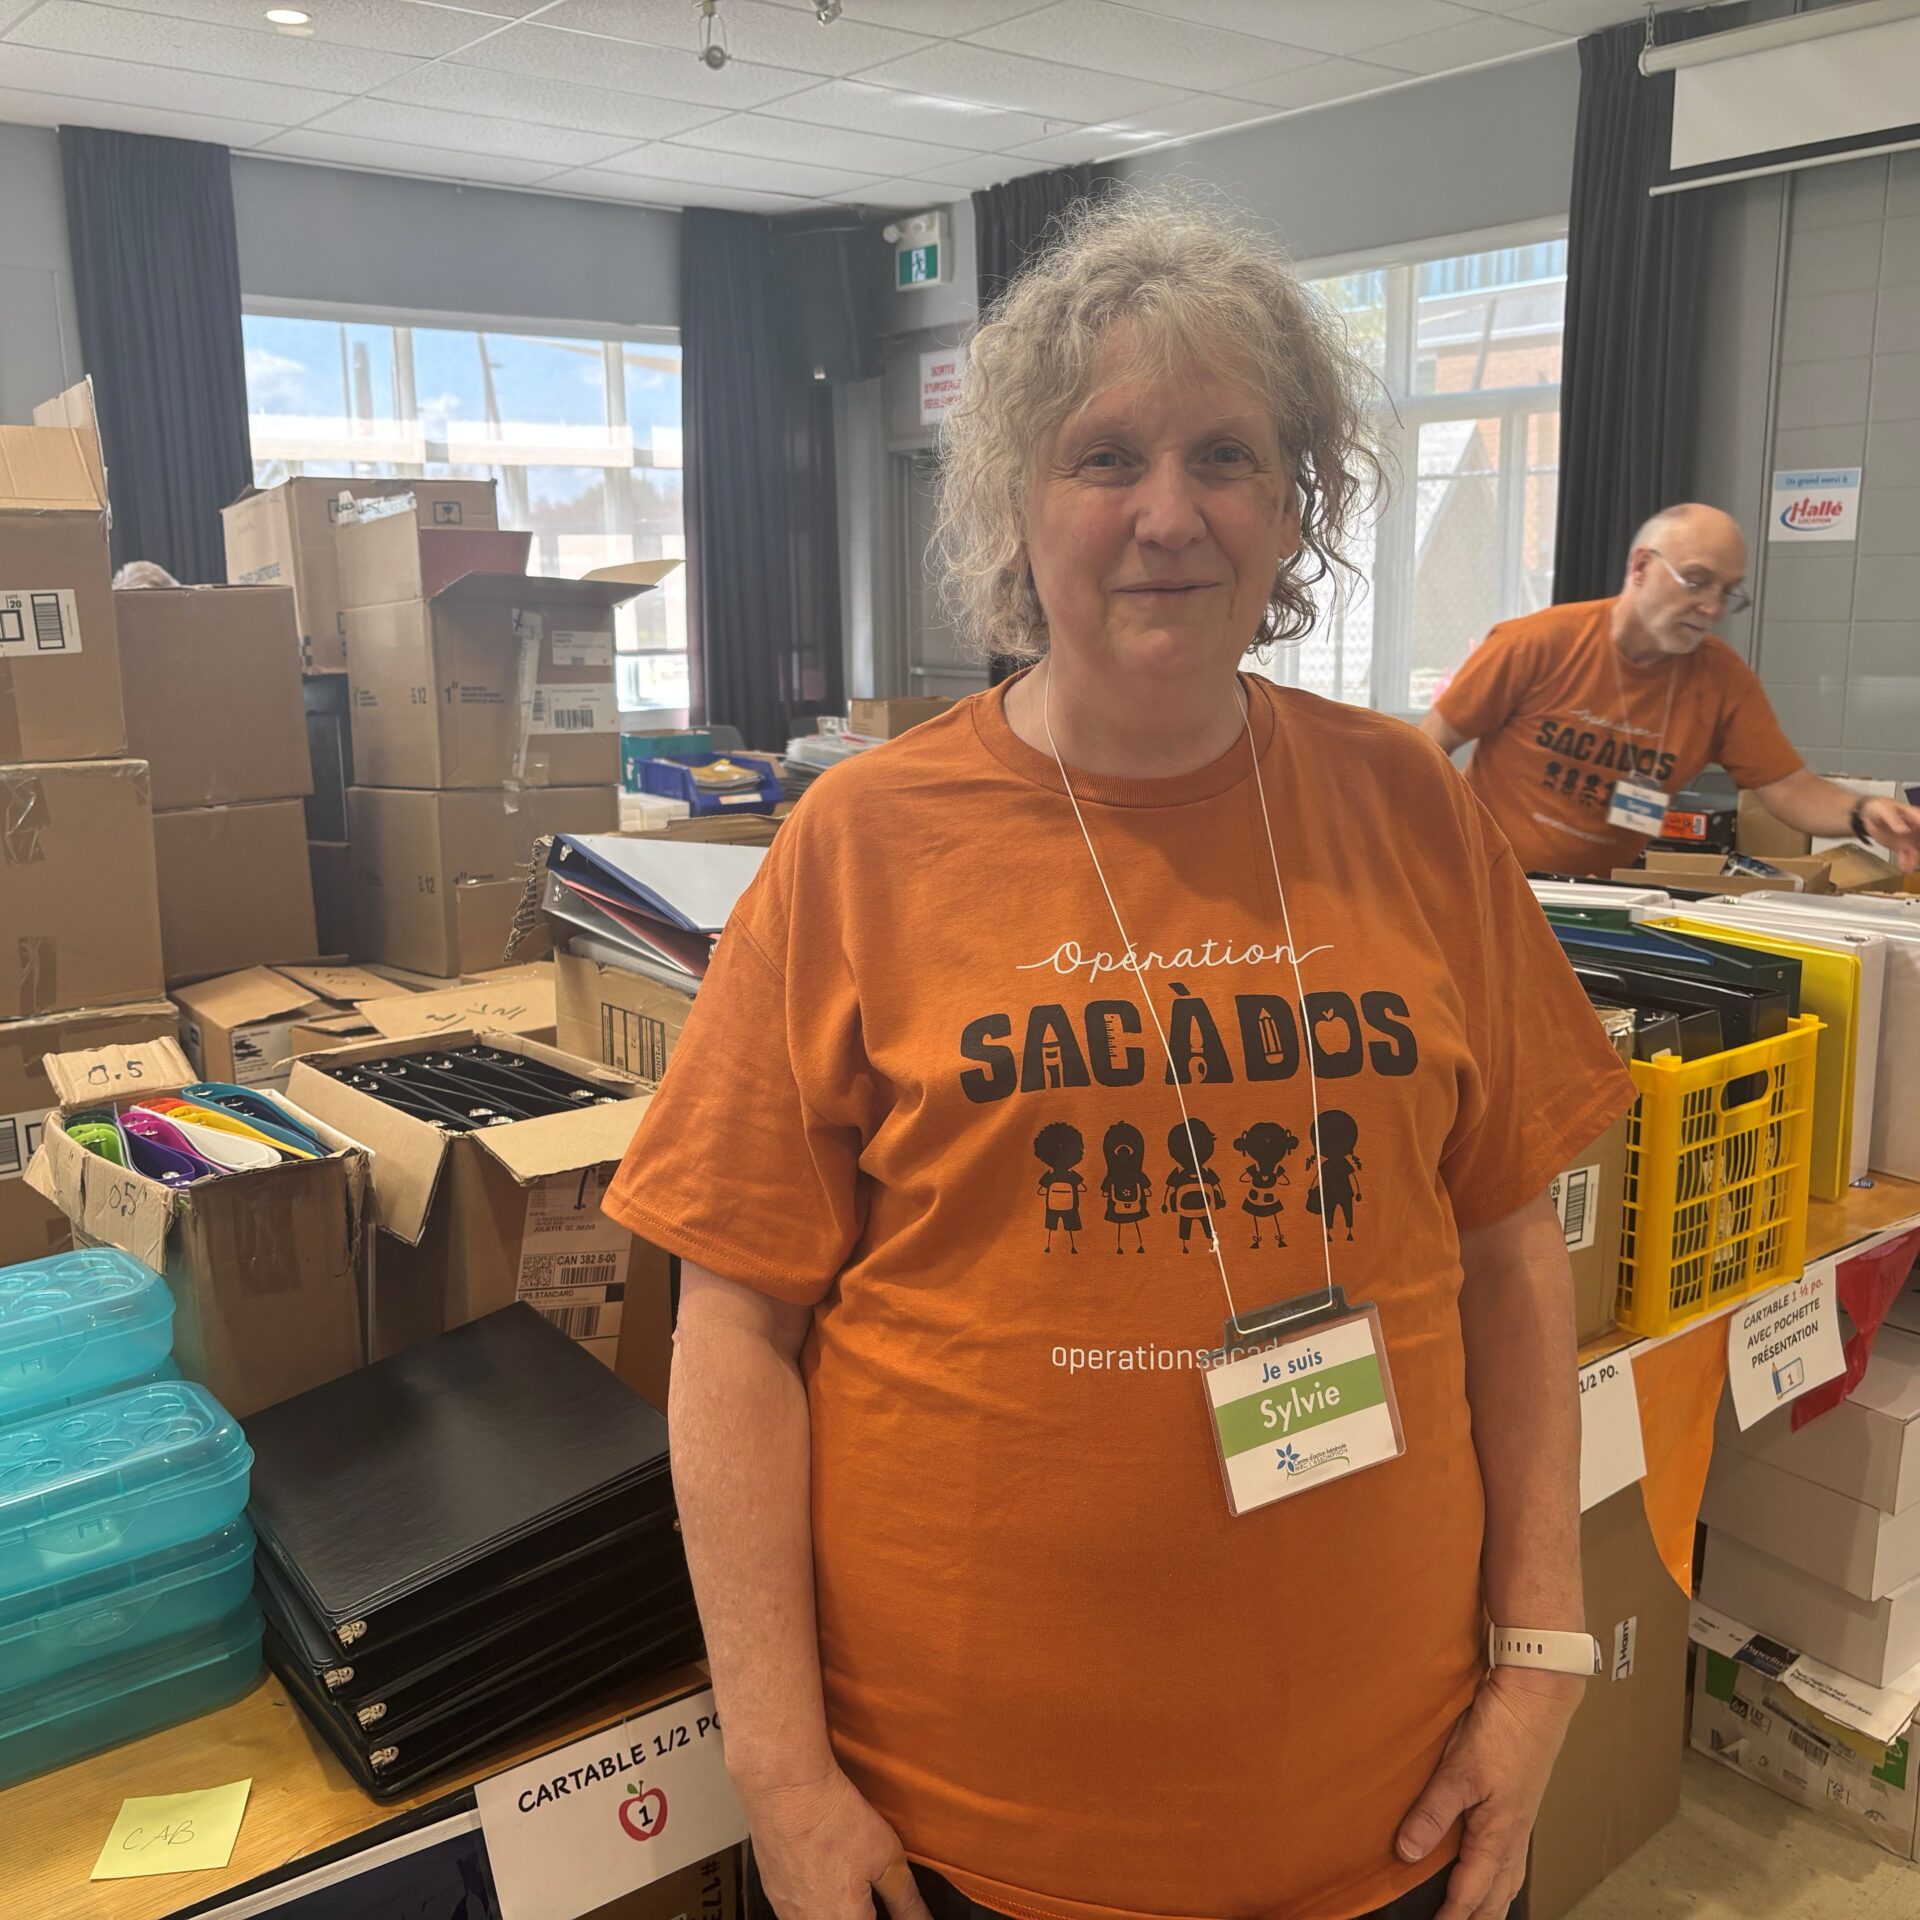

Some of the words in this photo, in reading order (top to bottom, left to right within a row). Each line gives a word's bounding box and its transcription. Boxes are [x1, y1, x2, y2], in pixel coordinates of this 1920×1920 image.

[1789, 497, 1843, 522] Hallé
[9, 600, 22, 609] 20
[1536, 720, 1596, 760] SAC
[1616, 742, 1677, 780] DOS
[1016, 939, 1335, 984] Opération
[959, 999, 1146, 1104] SAC
[1165, 982, 1235, 1086] À
[1234, 990, 1419, 1083] DOS
[557, 1255, 578, 1265] CAN
[580, 1255, 596, 1265] 382
[535, 1289, 574, 1299] STANDARD
[1743, 1294, 1790, 1330] CARTABLE
[1747, 1326, 1772, 1349] AVEC
[1774, 1297, 1821, 1334] POCHETTE
[1751, 1320, 1819, 1369] PRÉSENTATION
[1262, 1362, 1282, 1384] Je
[1287, 1347, 1324, 1375] suis
[1579, 1374, 1598, 1394] 1/2
[1599, 1365, 1620, 1384] PO.
[1787, 1373, 1795, 1386] 1
[1259, 1381, 1341, 1433] Sylvie
[517, 1743, 647, 1813] CARTABLE
[652, 1726, 691, 1757] 1/2
[638, 1804, 654, 1828] 1
[122, 1820, 195, 1851] CAB
